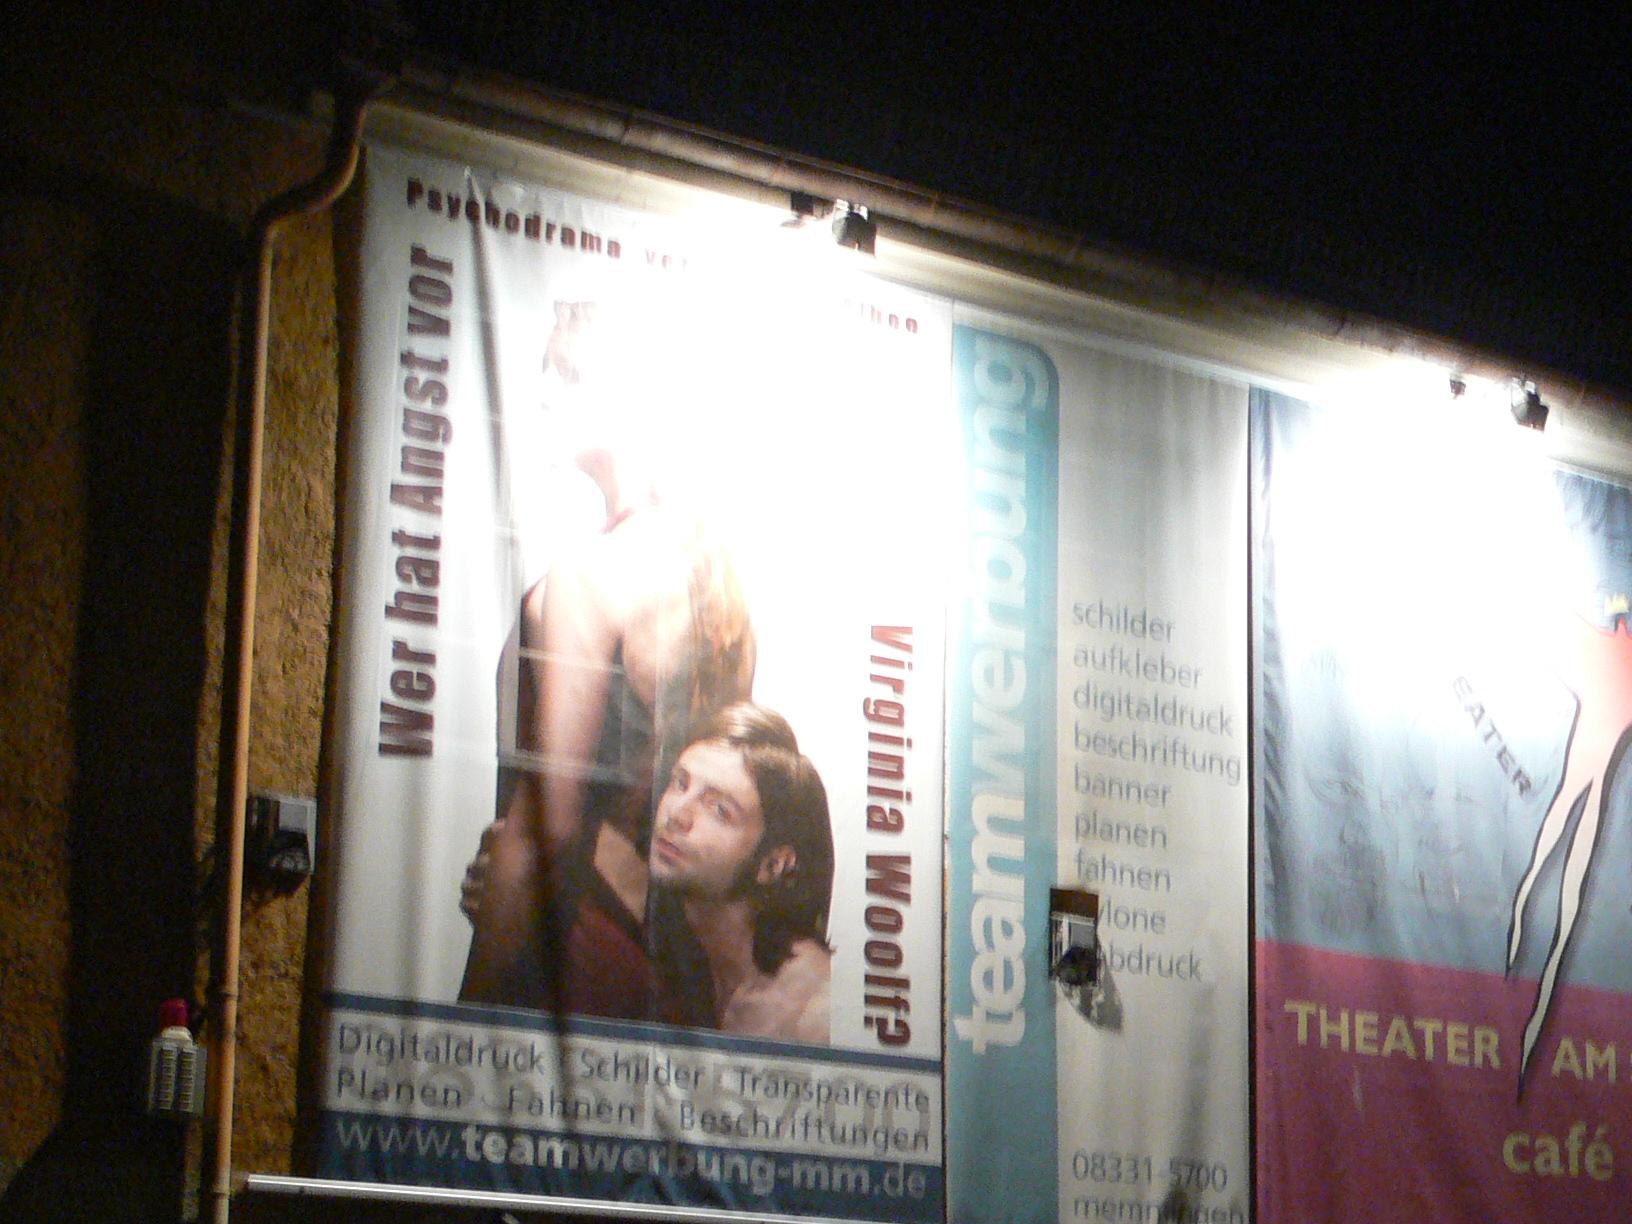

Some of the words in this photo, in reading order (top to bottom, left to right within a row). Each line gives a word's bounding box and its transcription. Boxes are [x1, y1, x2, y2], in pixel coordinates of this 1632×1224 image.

[405, 176, 622, 259] Psychodrama
[407, 244, 454, 338] vor
[390, 343, 453, 506] Angst
[385, 528, 441, 627] hat
[1072, 598, 1176, 643] schilder
[378, 638, 437, 758] Wer
[952, 336, 1050, 1056] teamwerbung
[1073, 642, 1203, 690] aufkleber
[862, 625, 913, 833] Virginia
[1072, 679, 1234, 738] digitaldruck
[1073, 720, 1242, 787] beschriftung
[1073, 762, 1173, 808] banner
[1073, 848, 1172, 893] fahnen
[1074, 811, 1169, 850] planen
[863, 853, 912, 1048] Woolf?
[1099, 896, 1168, 935] lone
[338, 1022, 545, 1076] Digitaldruck
[580, 1047, 704, 1091] Schilder
[738, 1065, 930, 1116] Transparente
[1285, 999, 1502, 1071] THEATER
[1550, 1035, 1617, 1087] AM
[337, 1066, 463, 1108] Planen
[508, 1085, 636, 1126] Fahnen
[679, 1101, 930, 1152] Beschriftungen
[1502, 1121, 1614, 1182] café
